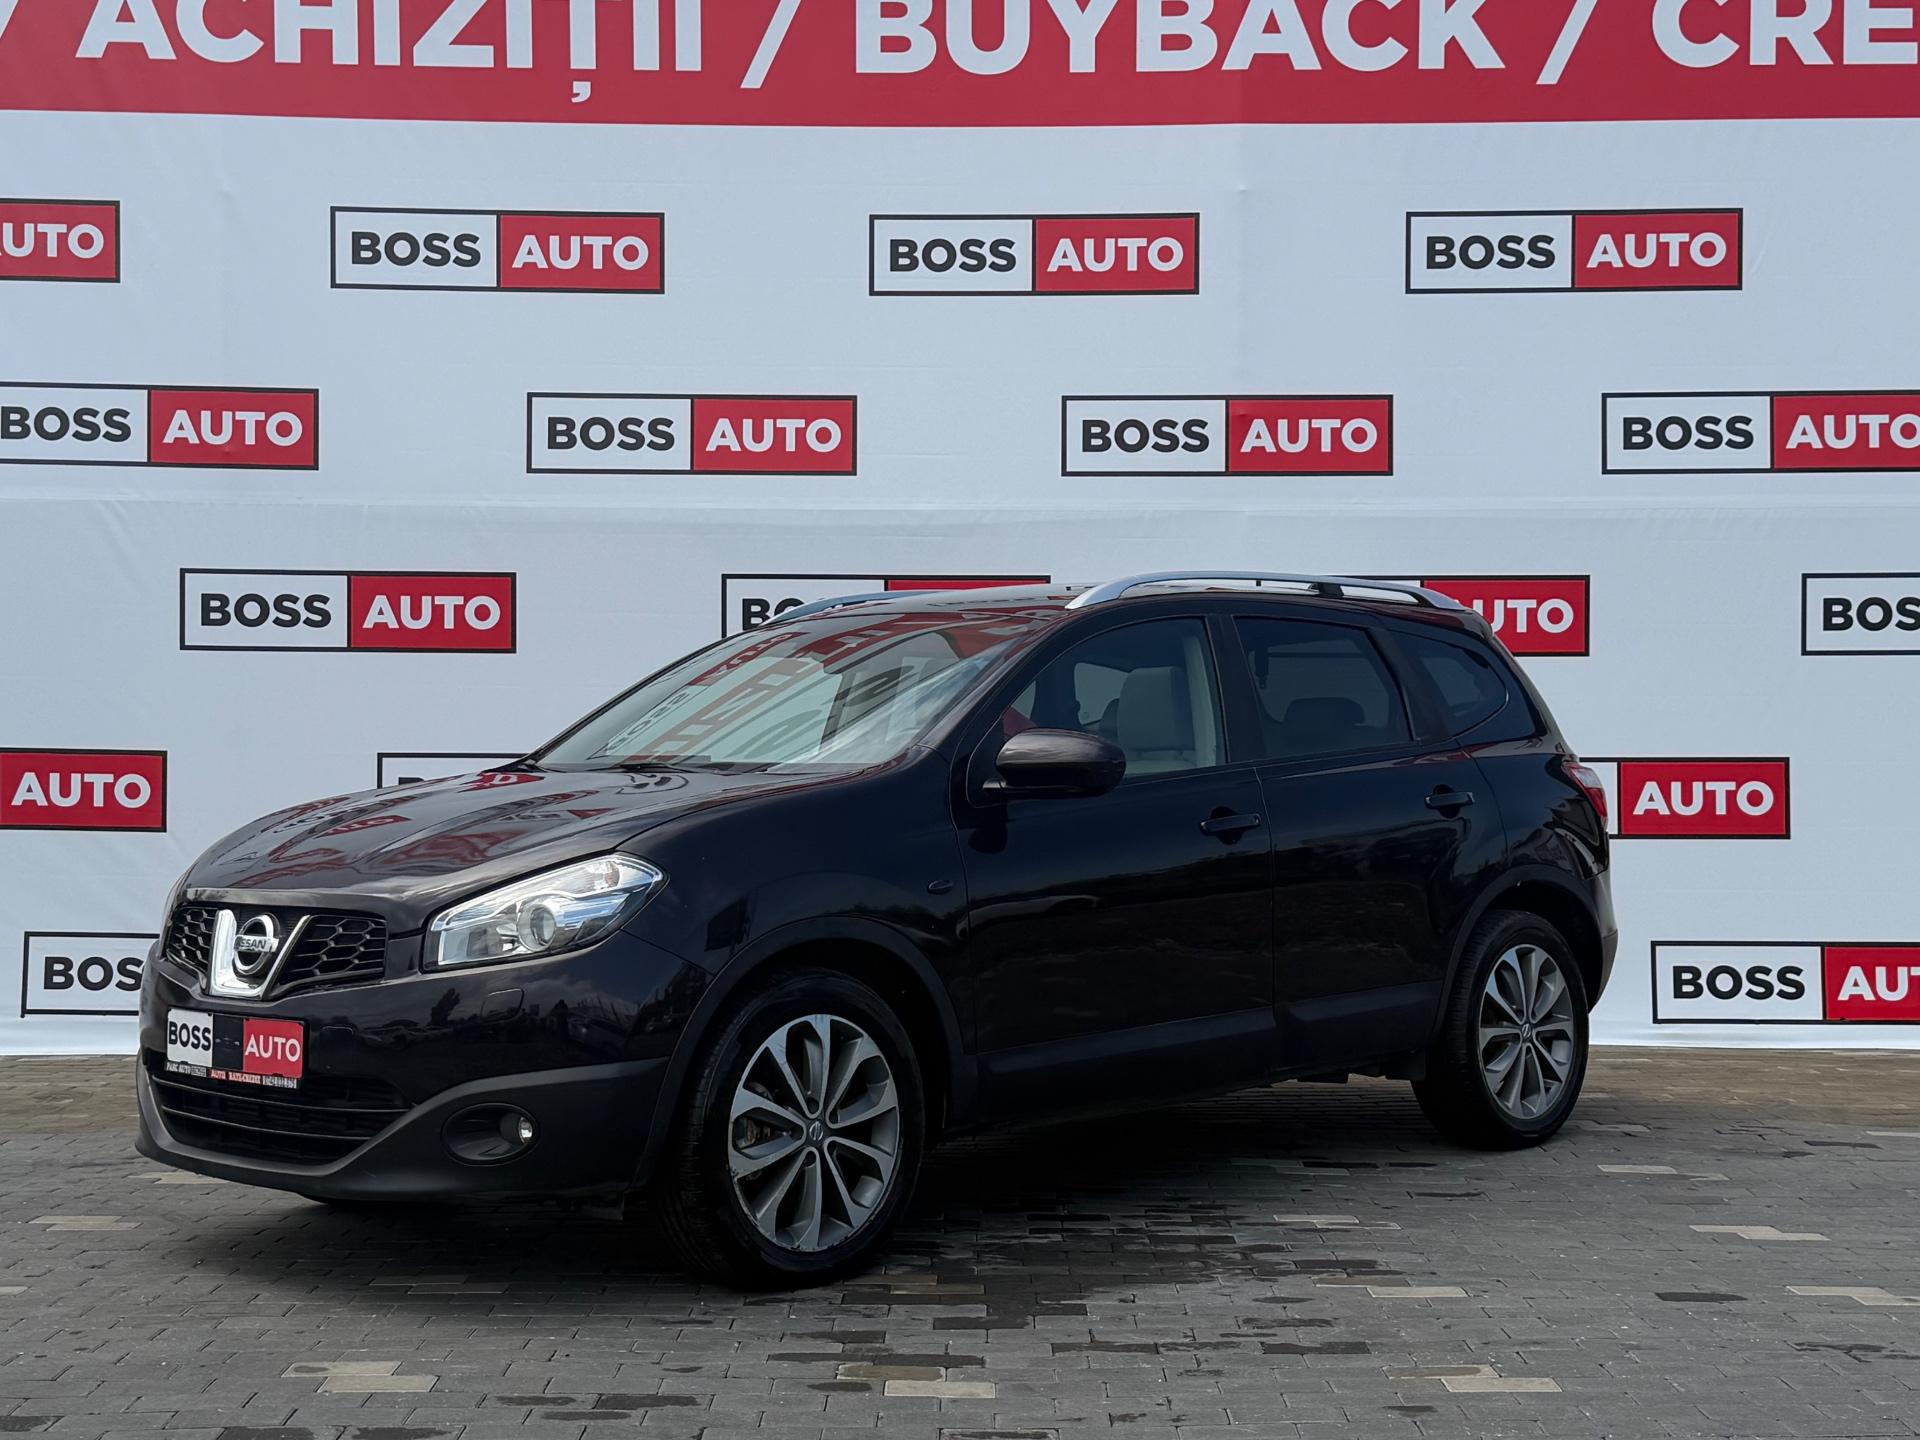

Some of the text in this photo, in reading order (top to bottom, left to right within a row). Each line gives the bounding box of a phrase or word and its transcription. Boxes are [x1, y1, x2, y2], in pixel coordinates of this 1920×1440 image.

[75, 0, 702, 103] ACHIZIȚII
[855, 0, 1506, 75] BUYBACK
[1652, 0, 1918, 68] CRE
[0, 223, 104, 259] UTO
[352, 232, 649, 271] BOSS AUTO
[890, 237, 1184, 273] BOSS AUTO
[1427, 233, 1727, 270] BOSS AUTO
[1, 406, 303, 447] BOSS AUTO
[548, 417, 842, 453] BOSS AUTO
[1083, 418, 1378, 453] BOSS AUTO
[1623, 414, 1920, 451] BOSS AUTO
[201, 593, 501, 630] BOSS AUTO
[1462, 599, 1574, 634] UTO
[12, 773, 151, 809] AUTO
[1633, 781, 1774, 816] AUTO
[44, 957, 145, 992] BOS
[1673, 965, 1806, 1001] BOSS
[168, 1021, 301, 1062] BOSS AUTO
